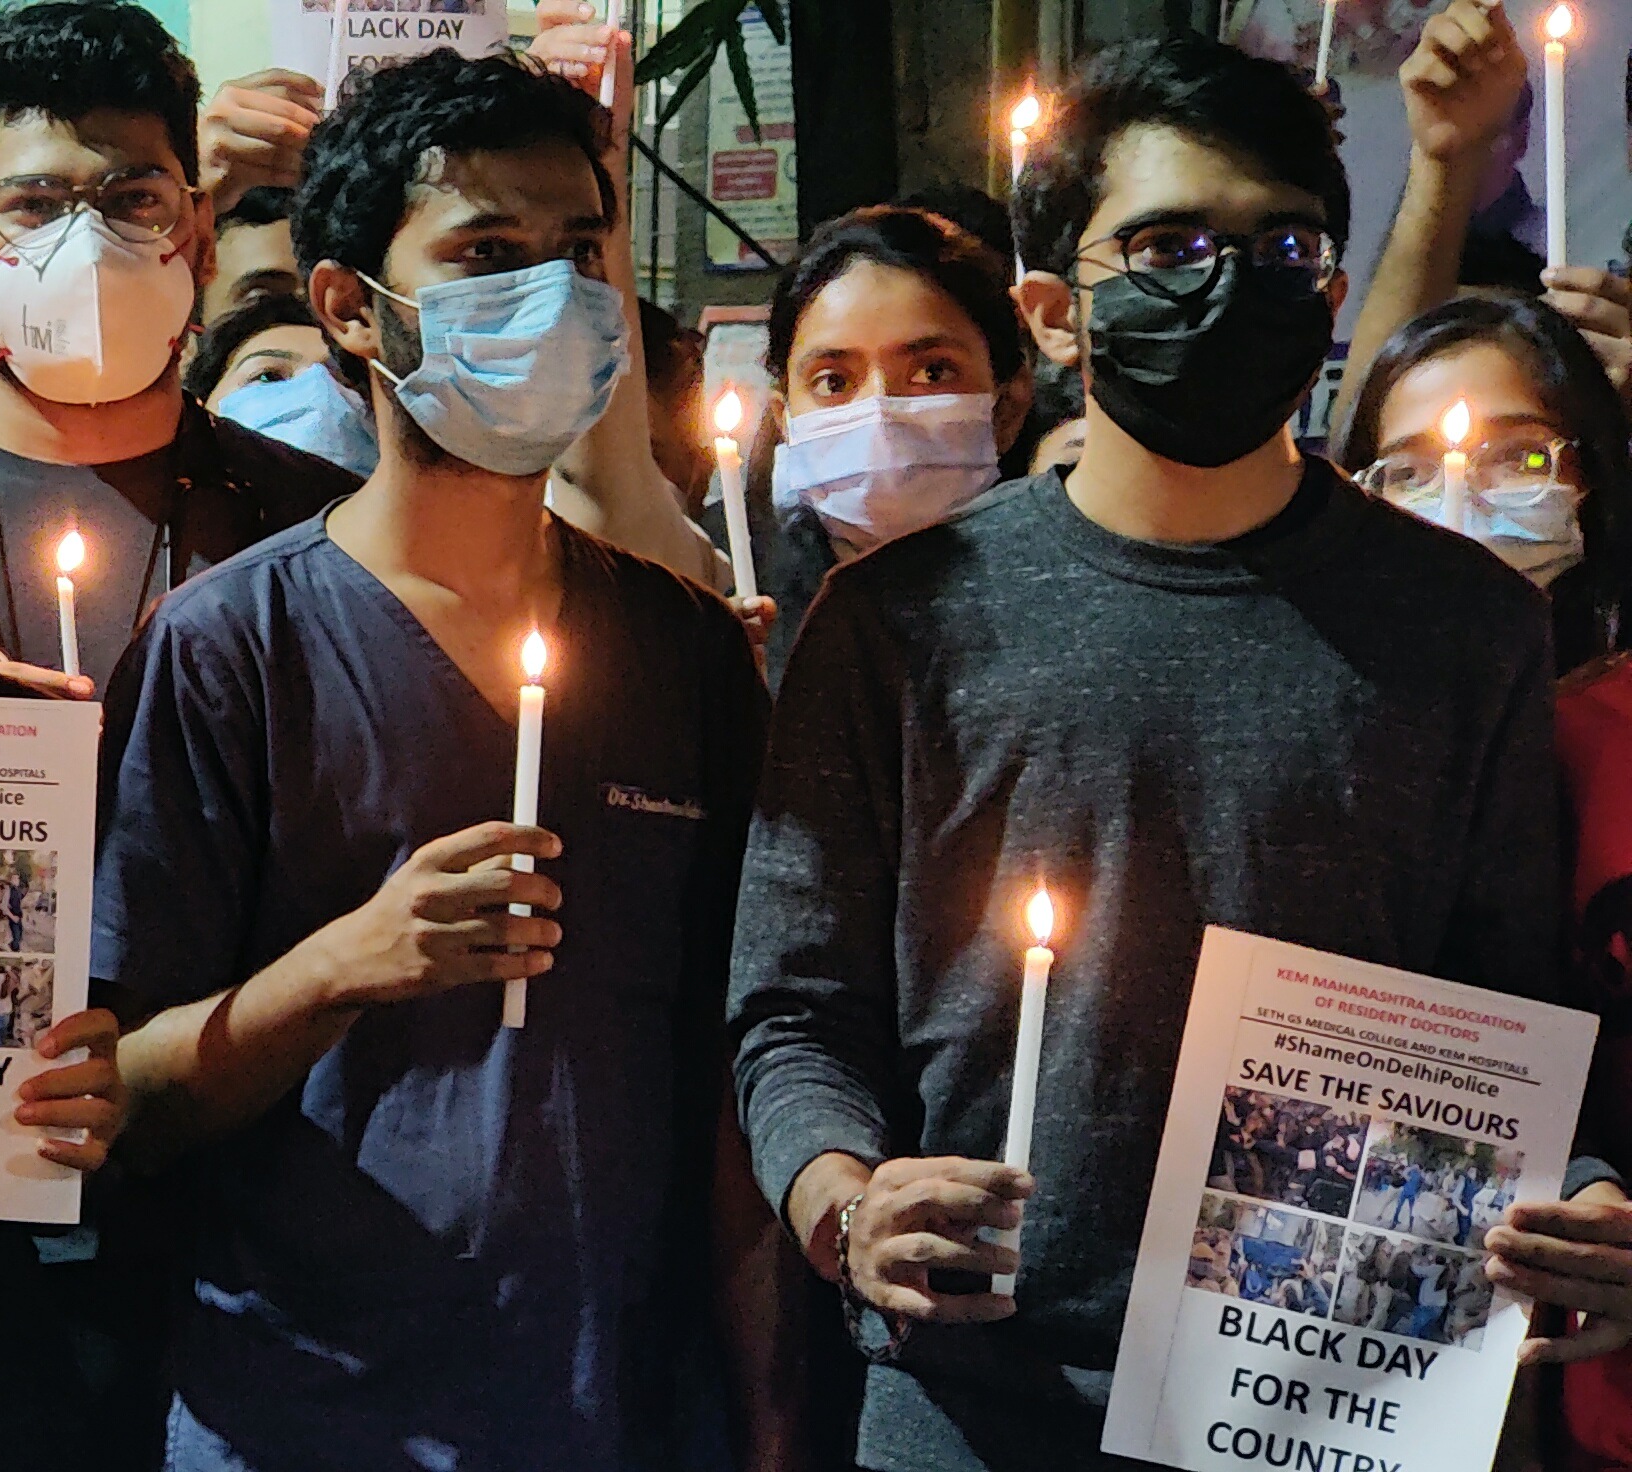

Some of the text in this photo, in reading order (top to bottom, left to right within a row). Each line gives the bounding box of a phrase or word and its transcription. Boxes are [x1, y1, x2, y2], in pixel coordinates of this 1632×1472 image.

[331, 17, 464, 40] LACK DAY
[1277, 968, 1527, 1034] KEM MAHARASHTRA ASSOCIATION
[1315, 996, 1480, 1042] OF RESIDENT DOCTORS
[1257, 1007, 1530, 1076] SETH GS MEDICAL COLLEGE AND KEM HOSPITALS
[1274, 1032, 1500, 1098] #ShameOnDelhiPolice
[1239, 1058, 1520, 1140] SAVE THE SAVIOURS
[1218, 1304, 1439, 1380] BLACK DAY
[1230, 1367, 1401, 1434] FOR THE
